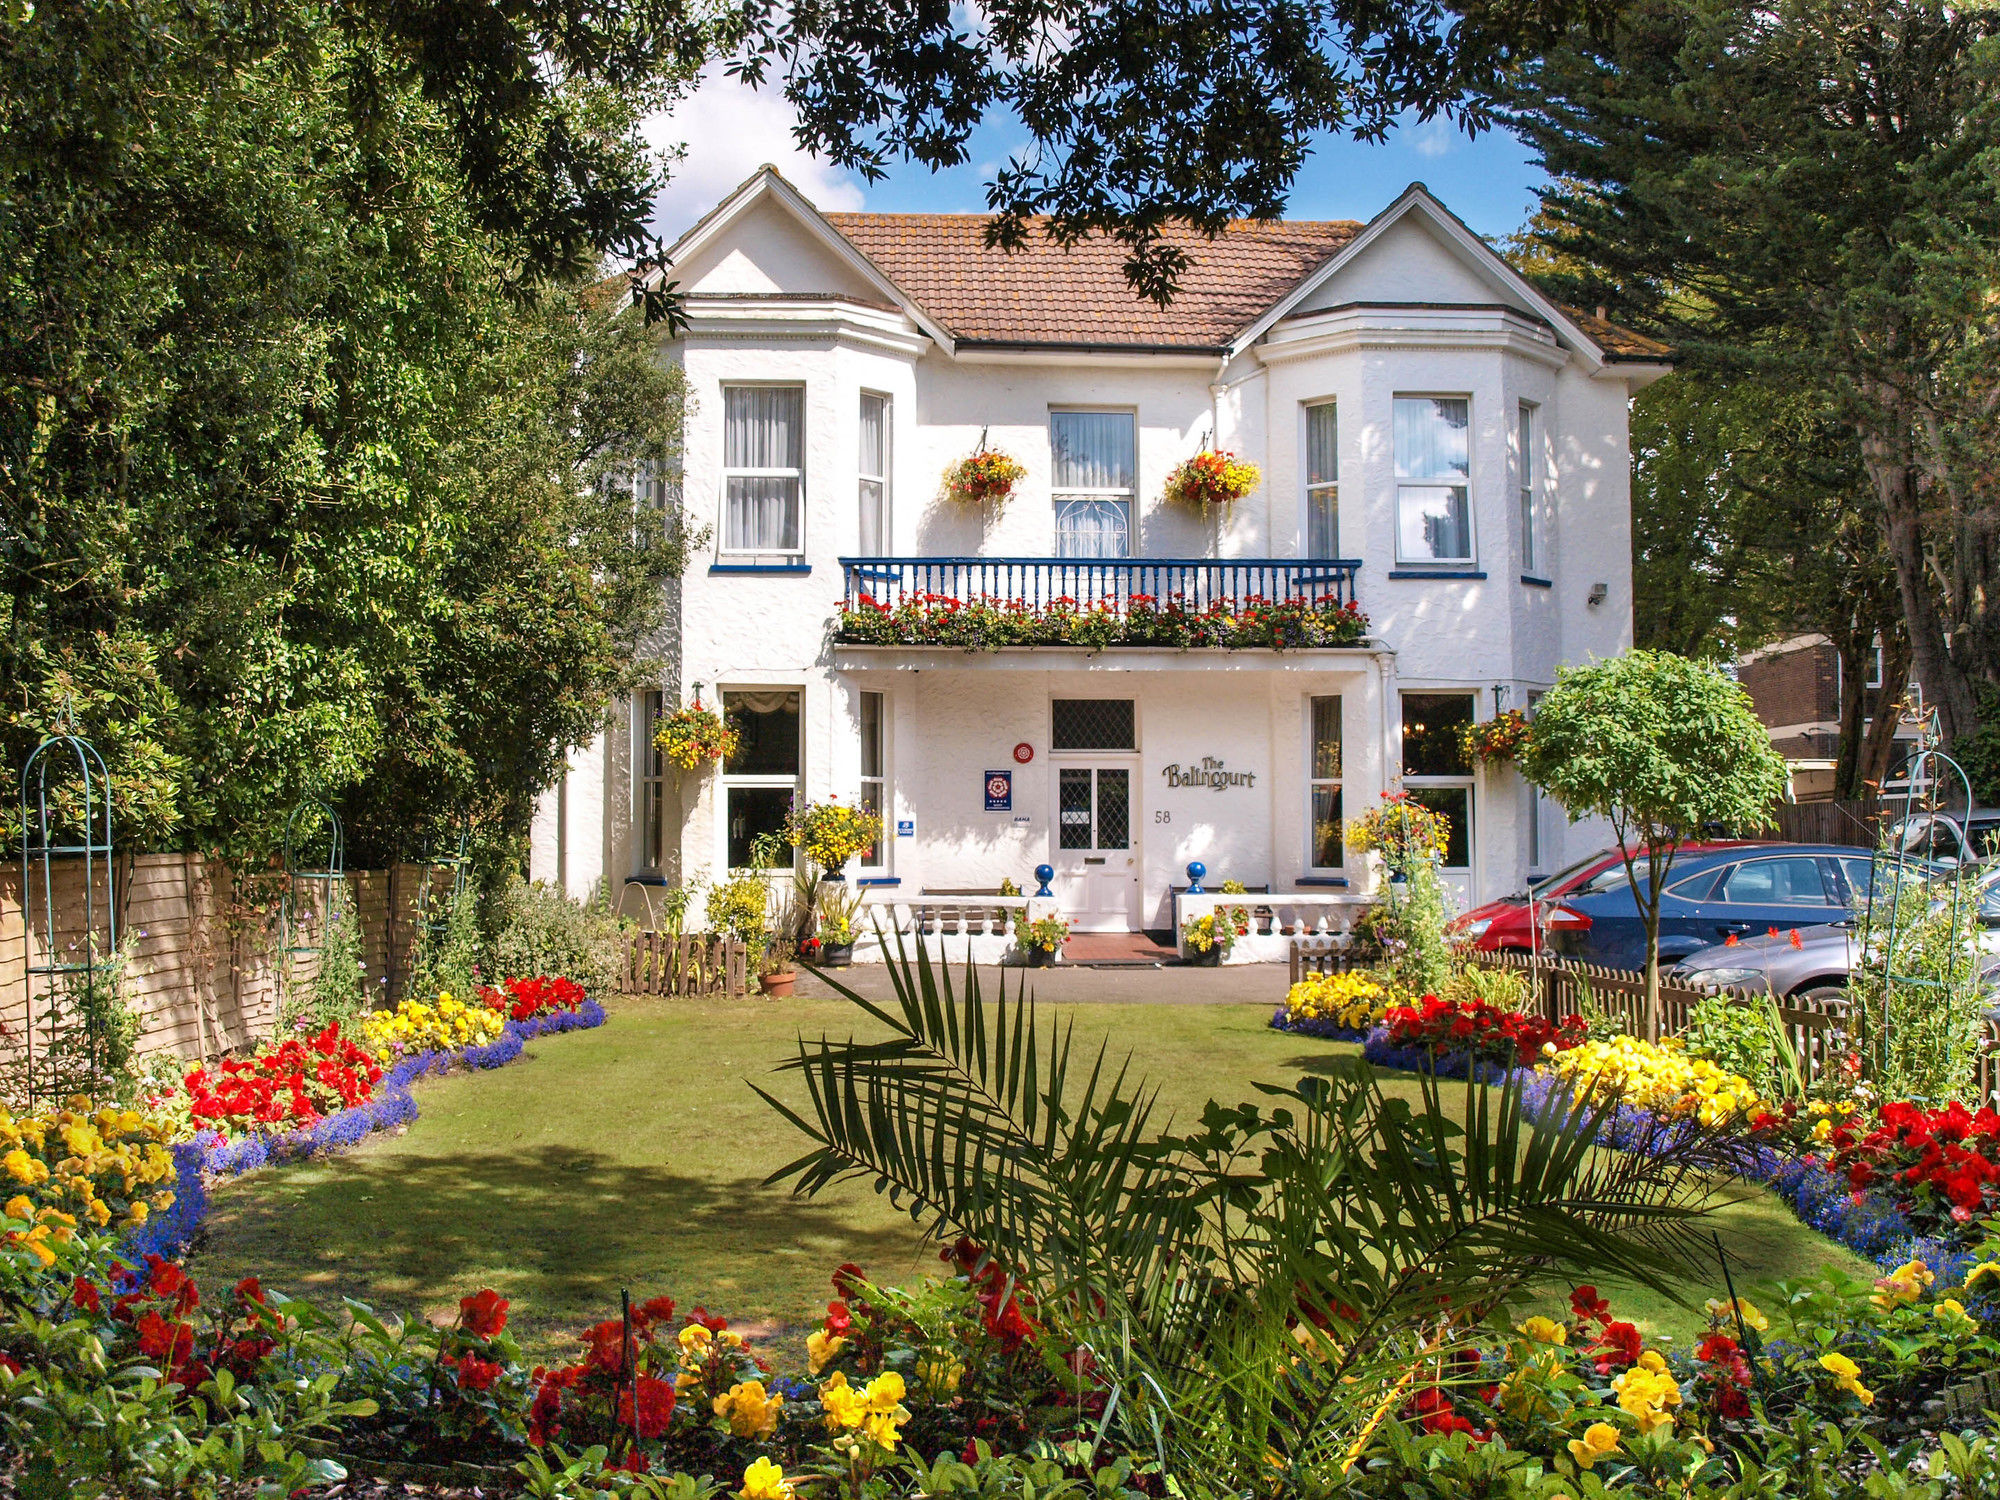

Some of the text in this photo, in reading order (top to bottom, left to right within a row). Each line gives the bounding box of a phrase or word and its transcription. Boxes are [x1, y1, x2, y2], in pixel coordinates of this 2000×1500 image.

[1202, 757, 1224, 770] The
[1162, 764, 1256, 792] Balincourt
[1155, 810, 1171, 824] 58
